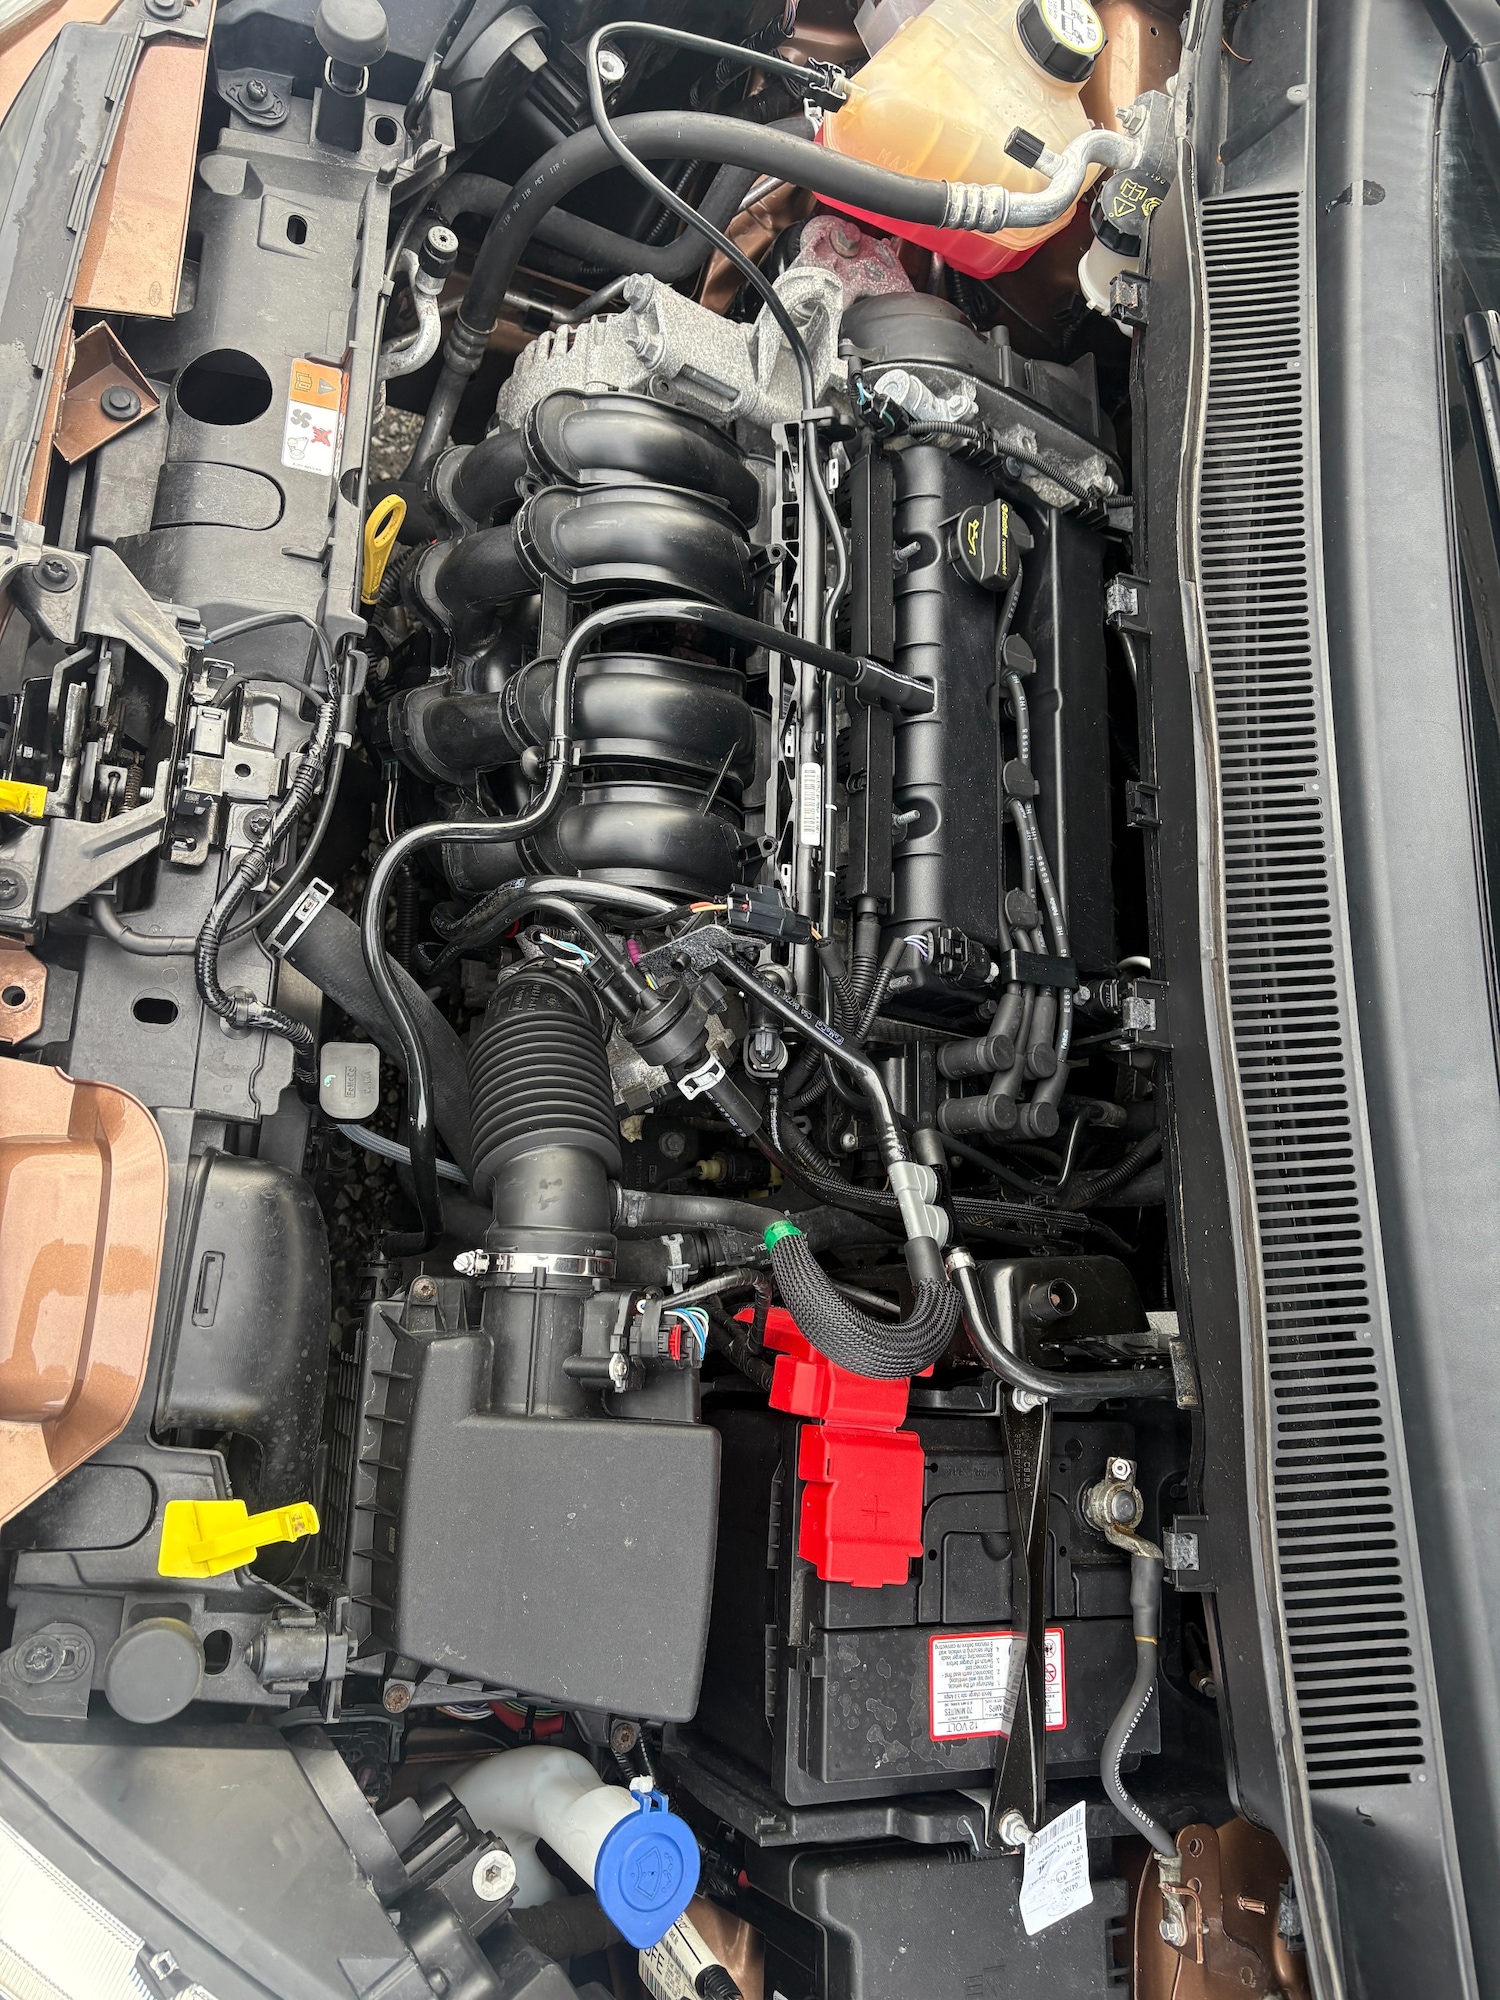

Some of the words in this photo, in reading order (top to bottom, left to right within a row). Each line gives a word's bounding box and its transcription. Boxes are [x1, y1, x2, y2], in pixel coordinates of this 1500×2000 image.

[877, 148, 914, 174] MAX
[1010, 673, 1020, 684] HE
[1018, 695, 1026, 711] 1H3
[1025, 804, 1032, 814] HE
[1037, 855, 1050, 884] E5595
[1049, 897, 1059, 916] FoMoCo
[1056, 925, 1063, 936] HE
[816, 1020, 844, 1044] FoMoCo
[944, 1708, 966, 1716] MINUTES
[946, 1722, 967, 1732] VOLT
[969, 1721, 978, 1729] 12
